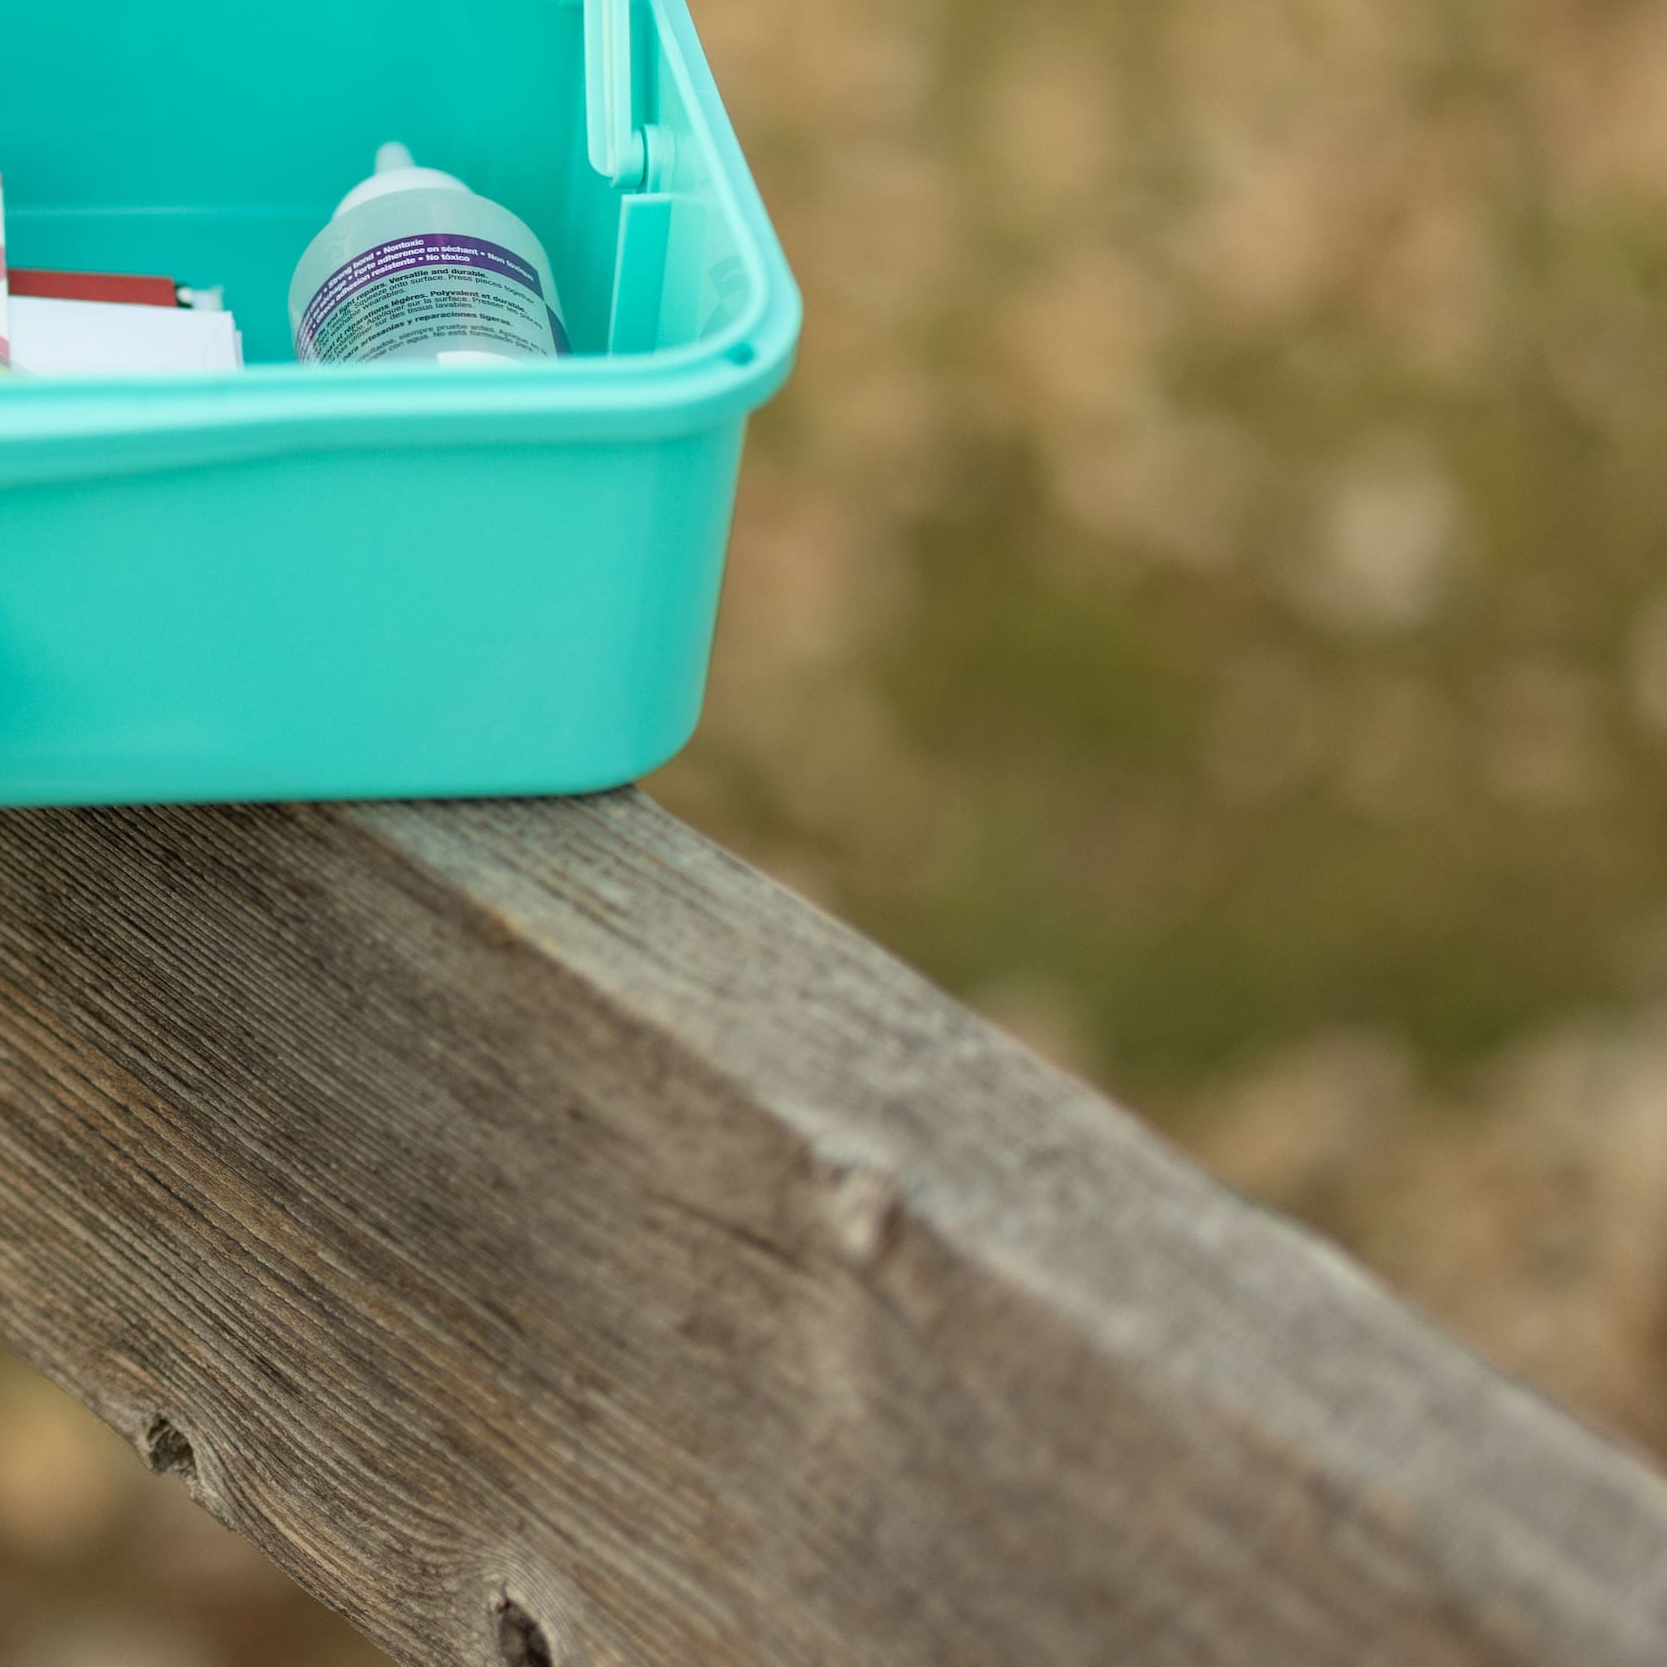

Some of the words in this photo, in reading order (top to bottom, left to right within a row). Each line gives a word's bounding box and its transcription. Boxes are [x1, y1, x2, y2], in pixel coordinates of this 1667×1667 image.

[328, 266, 353, 289] Strong
[353, 252, 375, 269] bond
[383, 239, 424, 254] Nontoxic
[354, 262, 376, 277] Forte
[441, 245, 479, 256] séchant
[371, 257, 416, 277] resistente
[389, 270, 429, 284] Versatile
[451, 268, 489, 279] durable.
[389, 281, 408, 291] onto
[448, 274, 473, 282] Press
[430, 290, 479, 298] Polyvalent
[407, 300, 421, 308] sur
[389, 311, 405, 321] des
[415, 312, 477, 323] reparaciones
